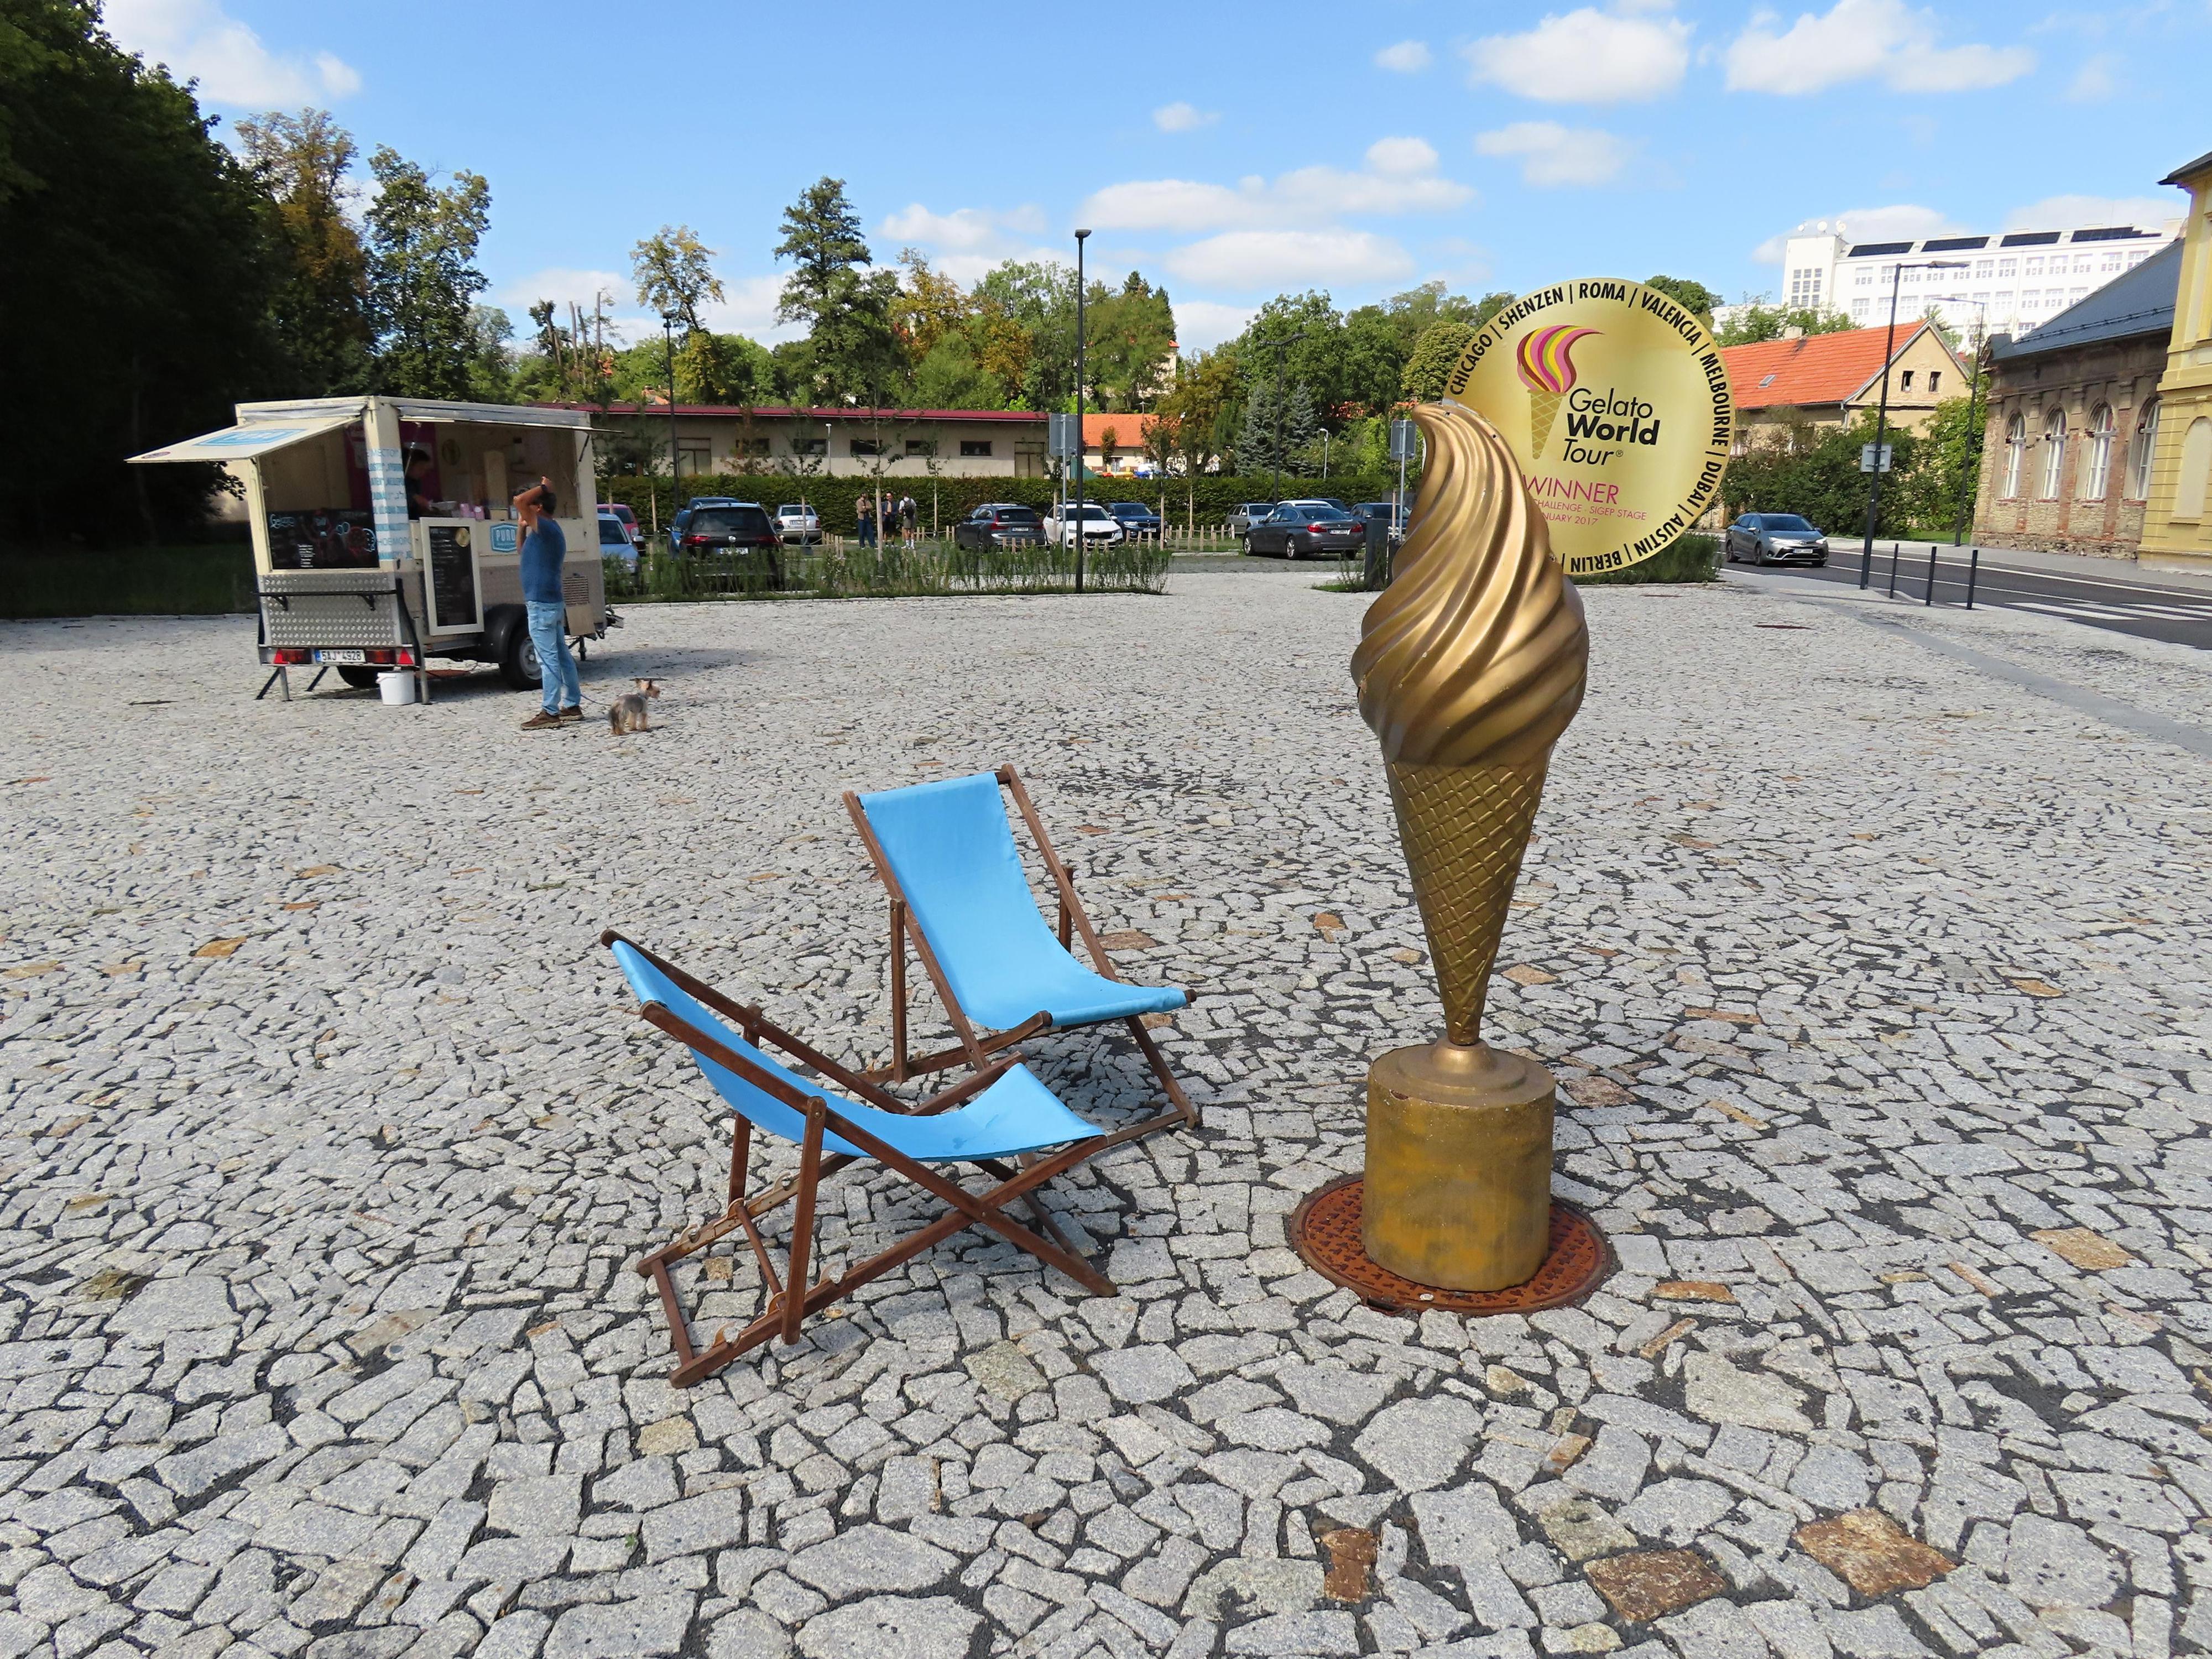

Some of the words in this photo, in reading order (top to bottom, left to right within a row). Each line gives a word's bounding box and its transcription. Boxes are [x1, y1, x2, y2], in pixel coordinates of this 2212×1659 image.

[1579, 282, 1626, 301] ROMA
[1498, 286, 1564, 330] SHENZEN
[1640, 291, 1703, 347] VALENCIA
[1450, 334, 1493, 395] CHICAGO
[1569, 388, 1653, 419] Gelato
[1699, 352, 1730, 447] MELBOURNE
[1567, 413, 1661, 445] World
[1522, 474, 1619, 505] WINNER
[1687, 461, 1723, 509] DUBAI
[1542, 512, 1572, 522] NUARY
[1574, 516, 1599, 525] 2017
[1589, 506, 1615, 516] SIGEP
[1617, 509, 1647, 520] STAGE
[1633, 513, 1685, 557] AUSTIN
[1571, 550, 1623, 572] BERLIN
